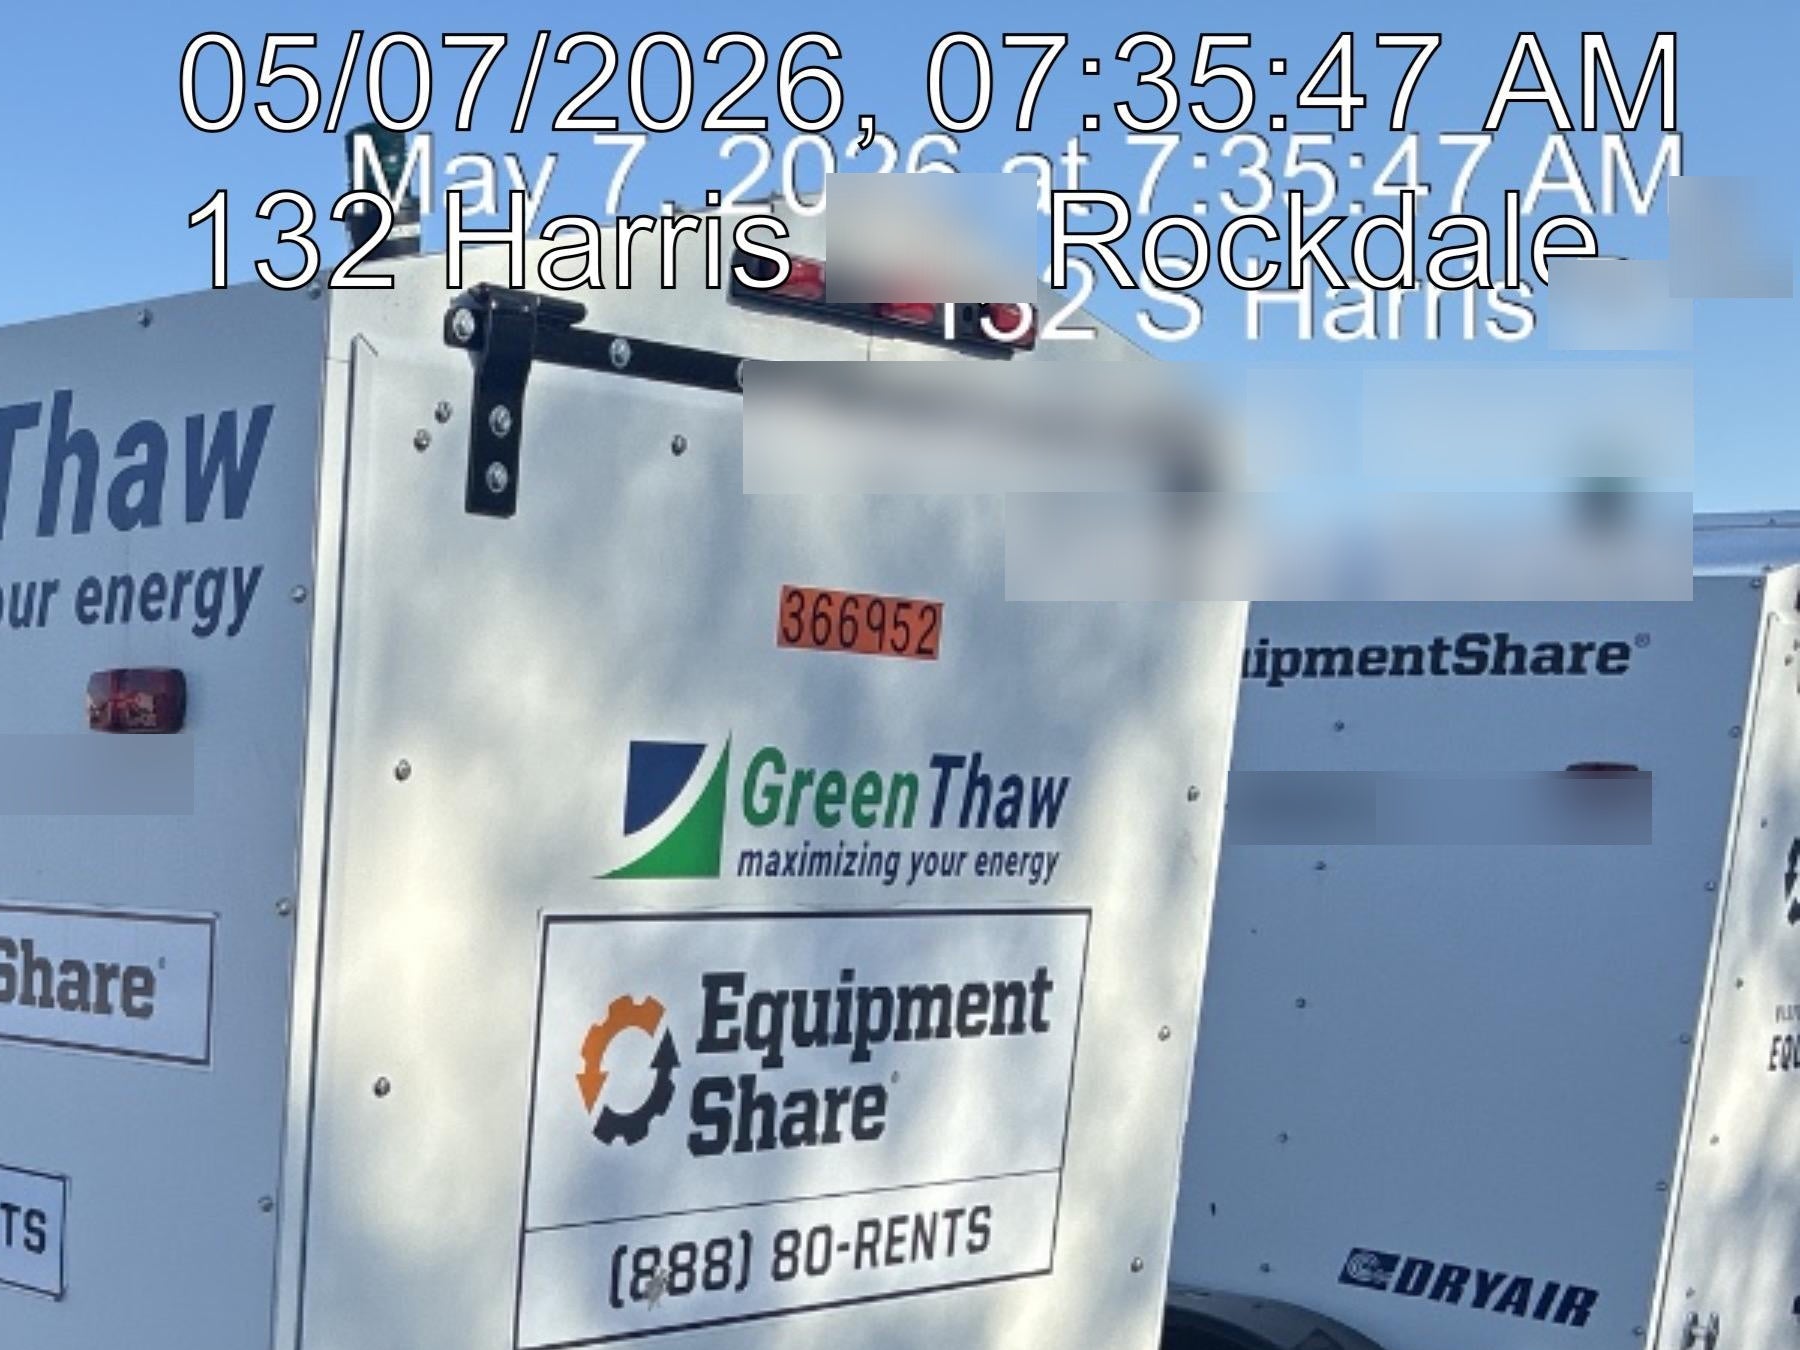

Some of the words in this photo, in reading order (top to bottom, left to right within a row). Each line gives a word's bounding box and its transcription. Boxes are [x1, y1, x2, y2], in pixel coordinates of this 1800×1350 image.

[76, 564, 265, 639] energy
[782, 589, 938, 656] 366952
[1241, 632, 1632, 688] ipmentShare
[737, 840, 900, 885] maximizing
[908, 846, 967, 882] your
[974, 847, 1061, 886] energy
[696, 967, 1054, 1070] Equipment
[687, 1072, 889, 1158] Share
[609, 1230, 753, 1309] (888)
[771, 1204, 993, 1283] 80-RENTS
[1393, 1256, 1599, 1328] DRYAIR
